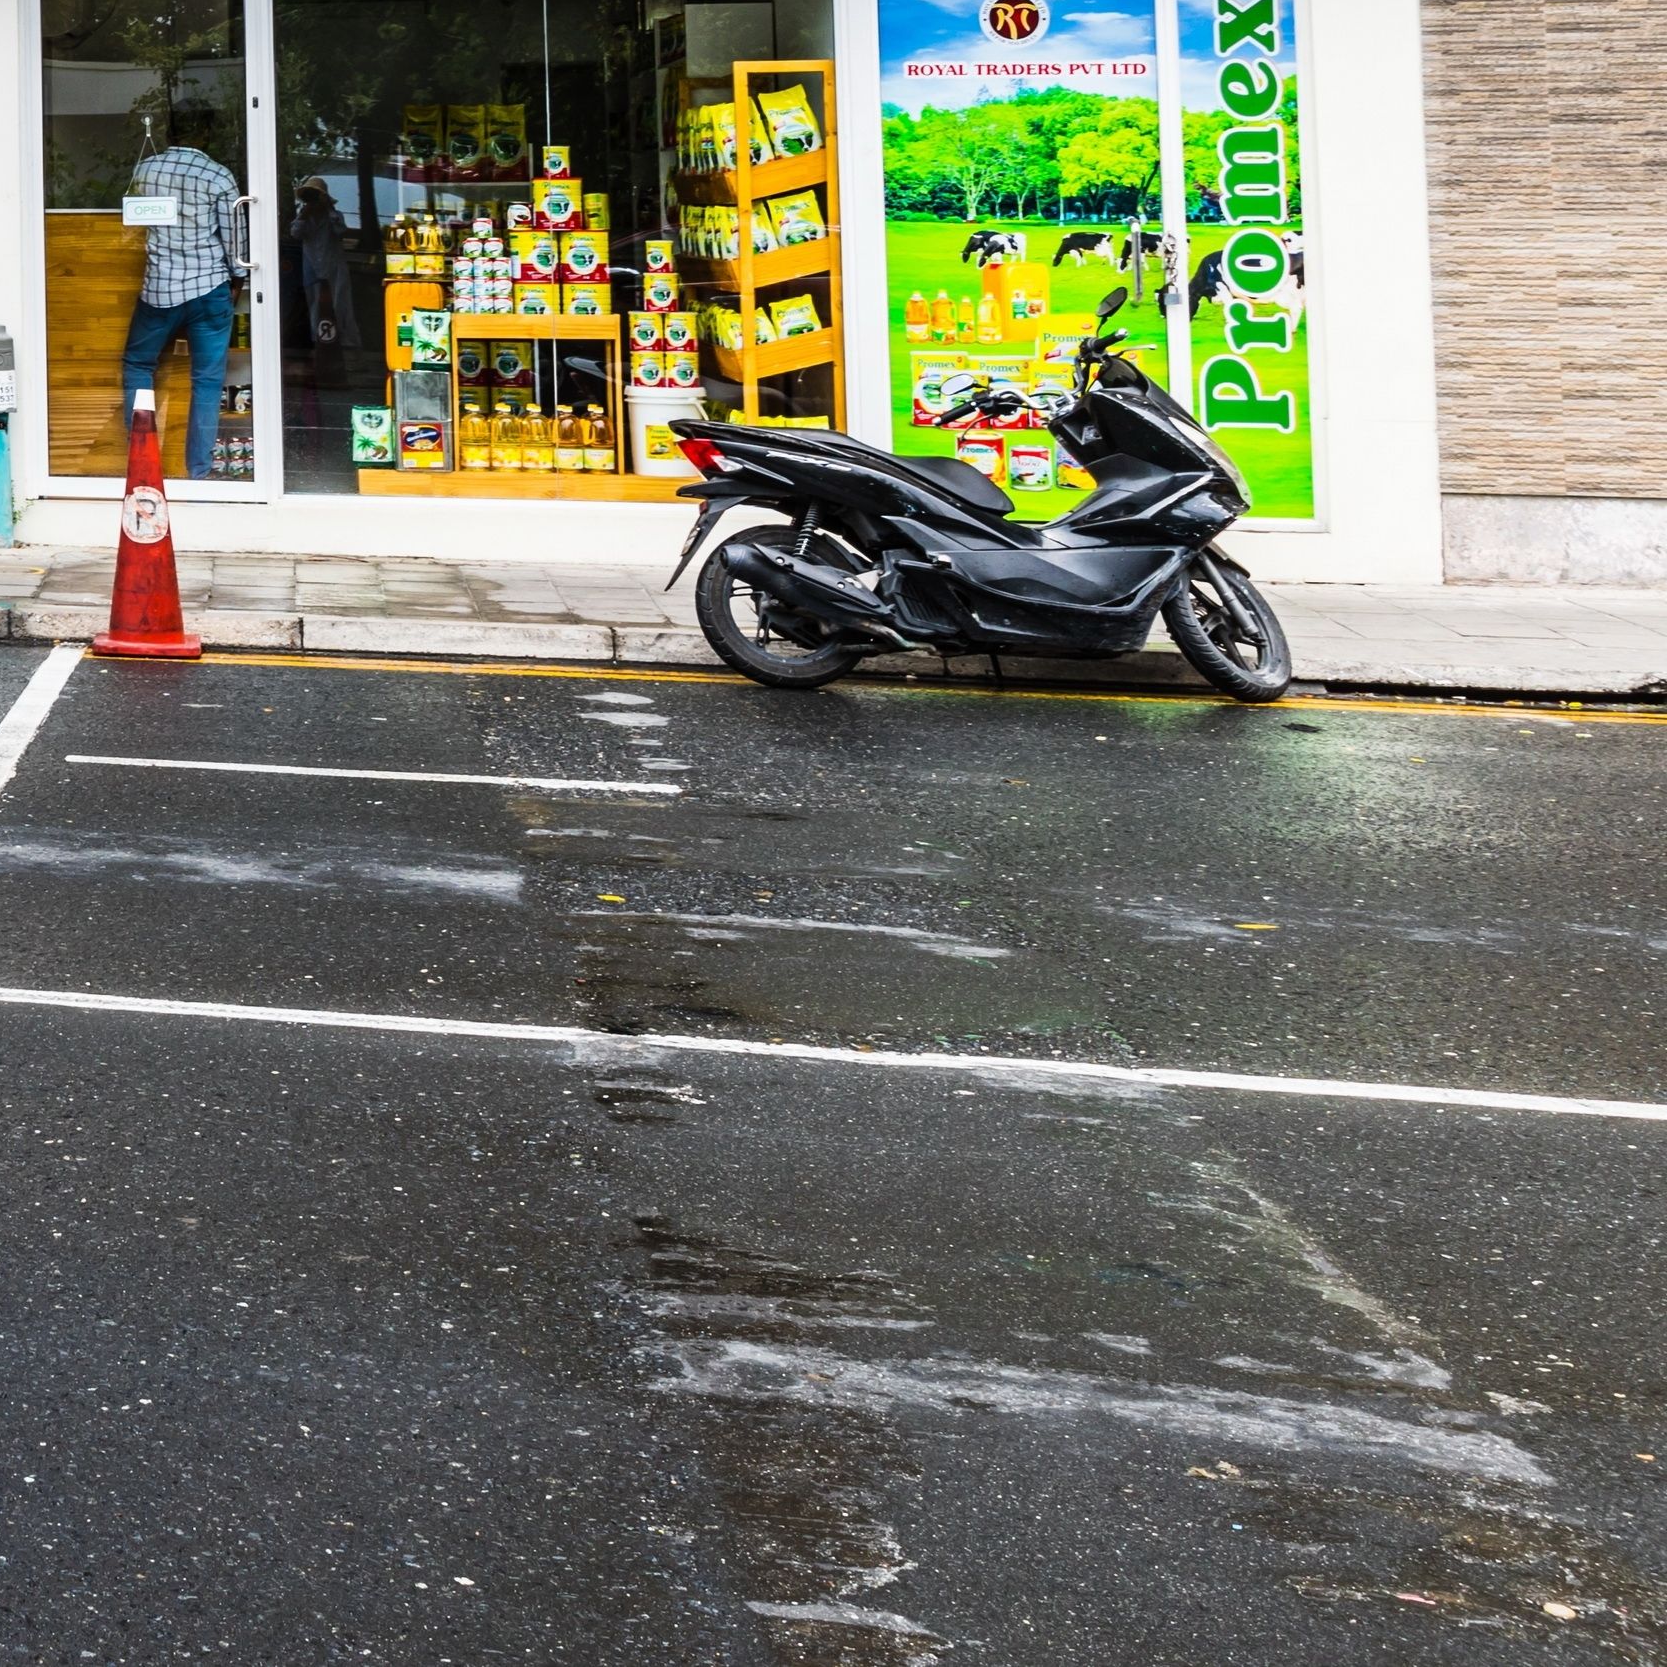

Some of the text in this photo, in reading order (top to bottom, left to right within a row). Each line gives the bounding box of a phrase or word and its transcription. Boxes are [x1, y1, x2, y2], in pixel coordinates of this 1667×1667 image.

[907, 63, 1147, 76] ROYAL TRADERS PVT LTD
[134, 205, 167, 215] OPEN
[917, 358, 957, 369] Promex
[979, 361, 1021, 373] Promex
